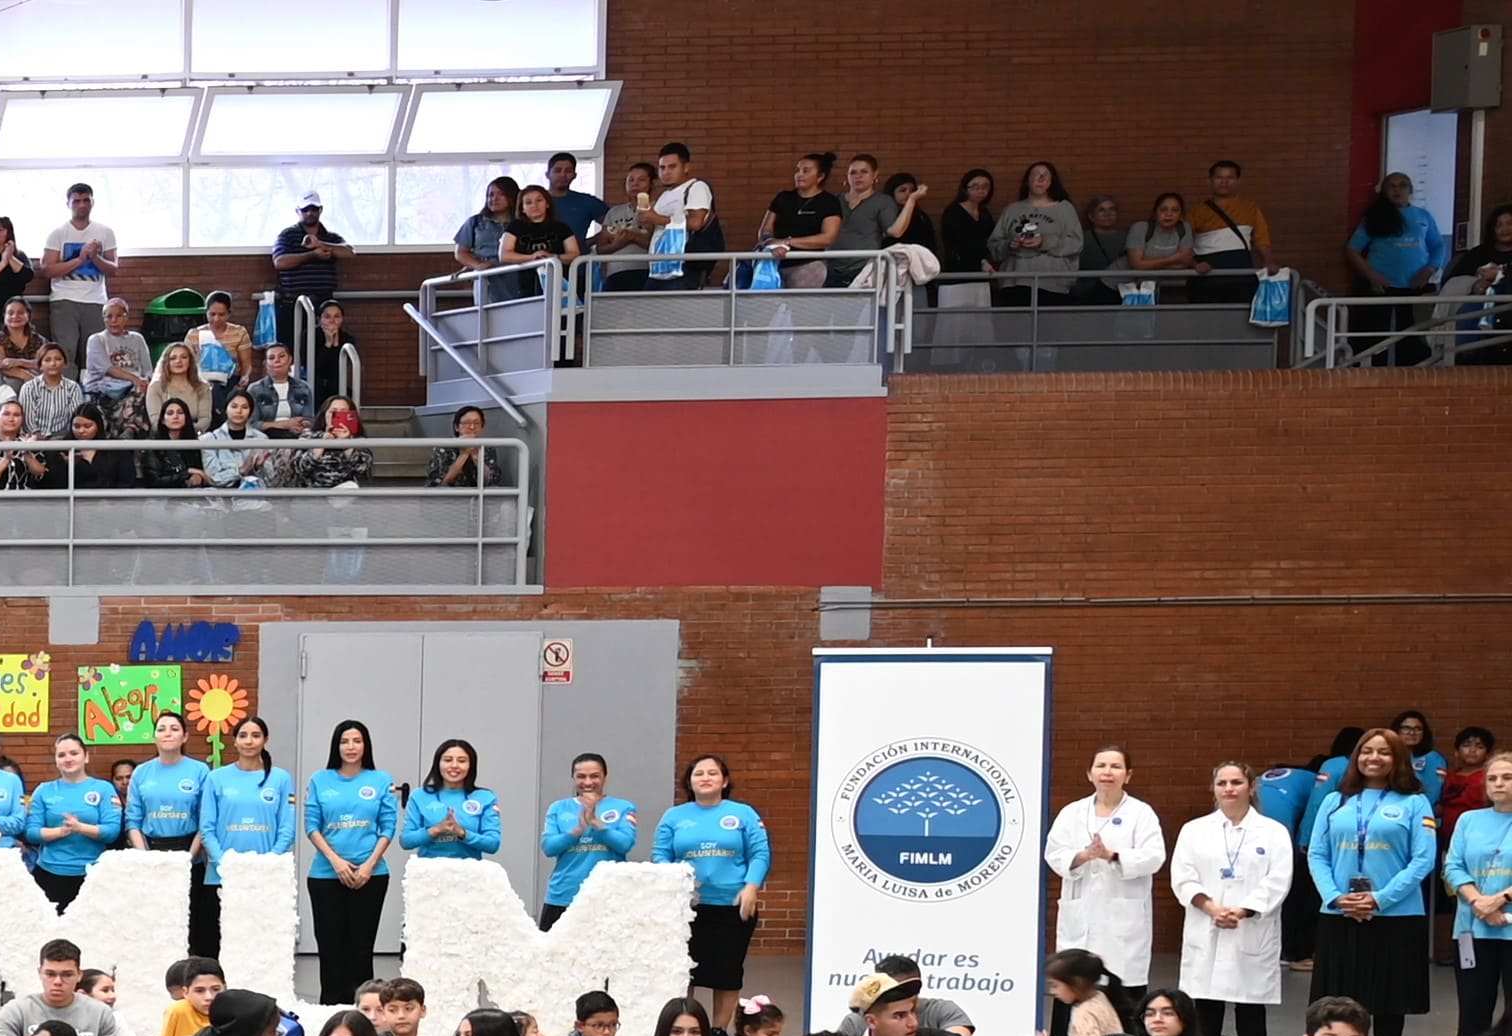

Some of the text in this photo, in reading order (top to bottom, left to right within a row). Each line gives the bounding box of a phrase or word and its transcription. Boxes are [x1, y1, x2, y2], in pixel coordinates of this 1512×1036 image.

[840, 741, 1016, 804] FUNDACIÓN INTERNACIONAL
[841, 843, 1013, 899] MARIA LUISA de MORENO
[899, 851, 953, 866] FIMLM
[954, 952, 980, 968] es
[927, 973, 1015, 1001] trabajo
